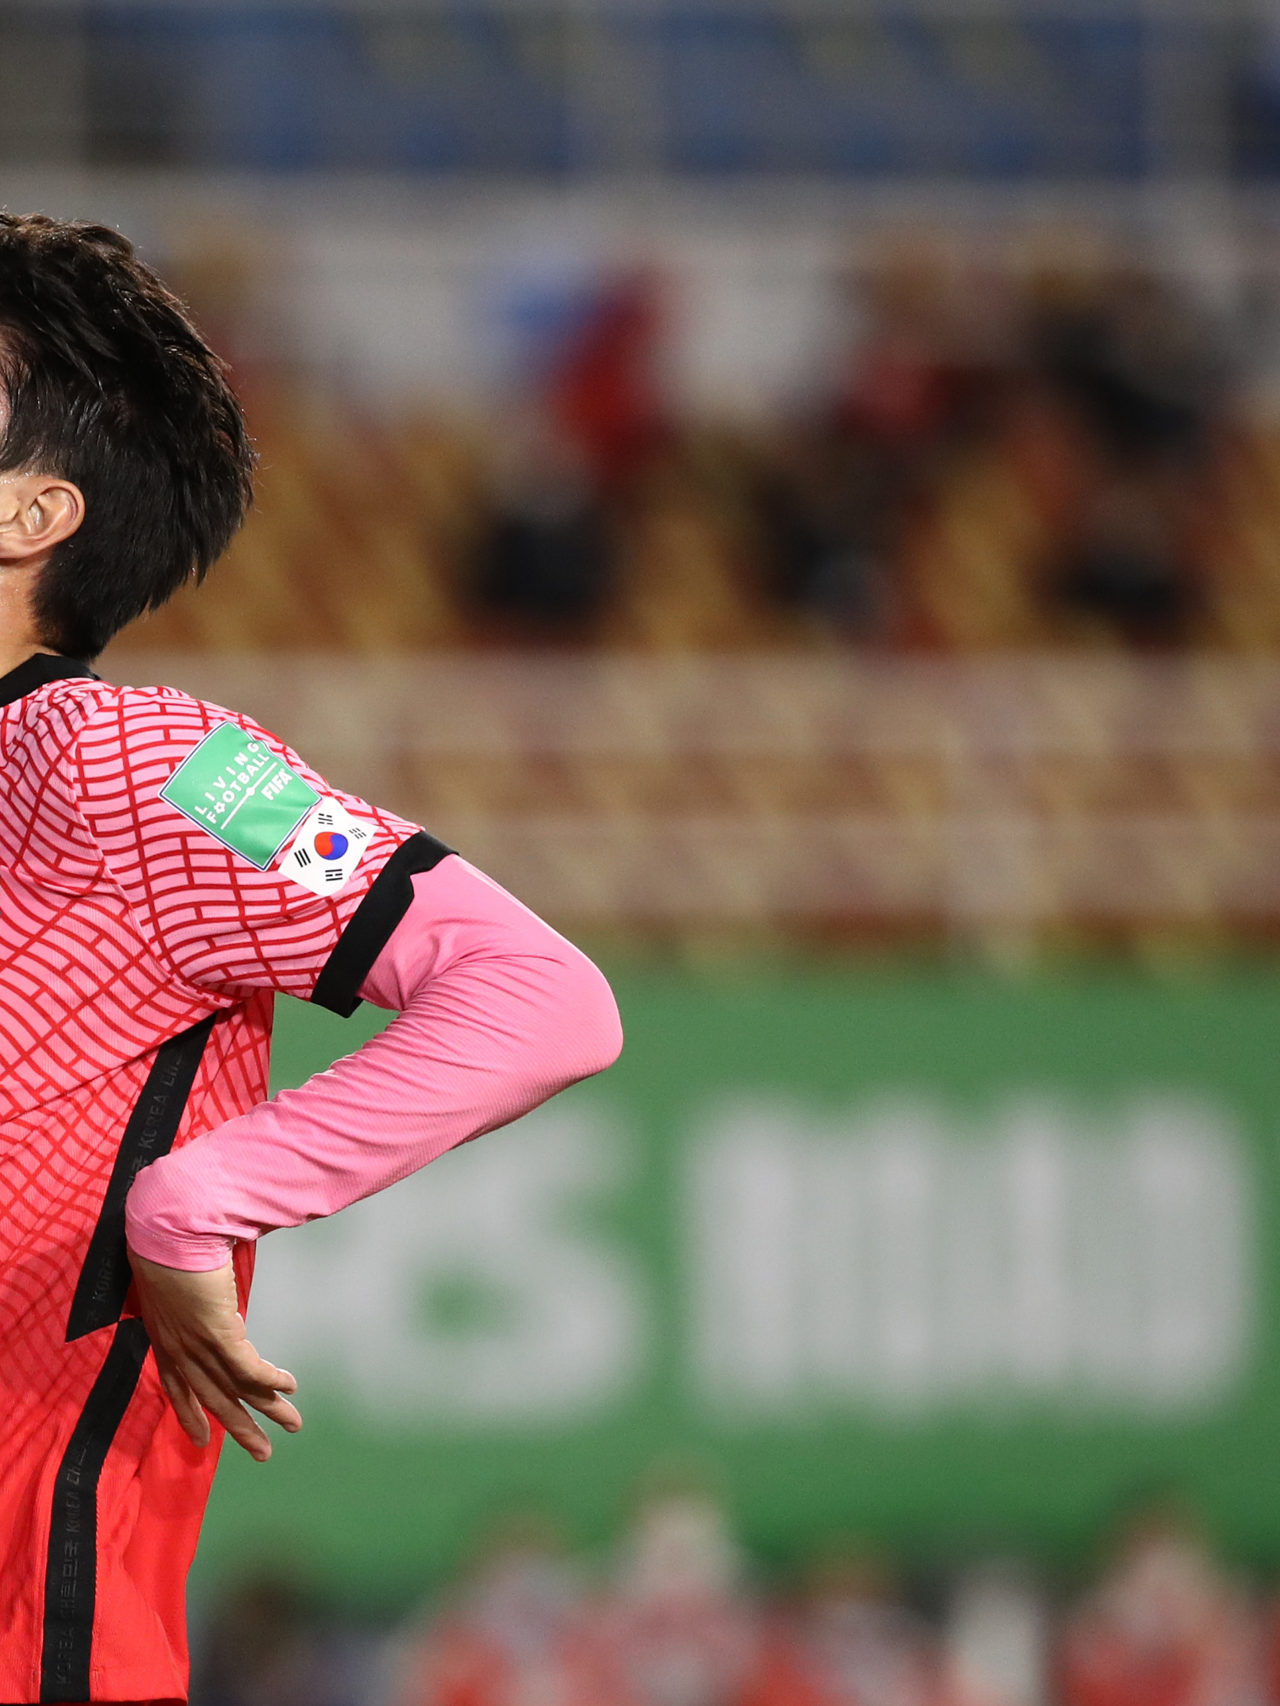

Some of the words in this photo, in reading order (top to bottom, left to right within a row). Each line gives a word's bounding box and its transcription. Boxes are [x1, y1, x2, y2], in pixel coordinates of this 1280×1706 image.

[194, 742, 260, 815] LIVING
[206, 753, 270, 824] FOOTBALL
[261, 769, 293, 801] FIFA
